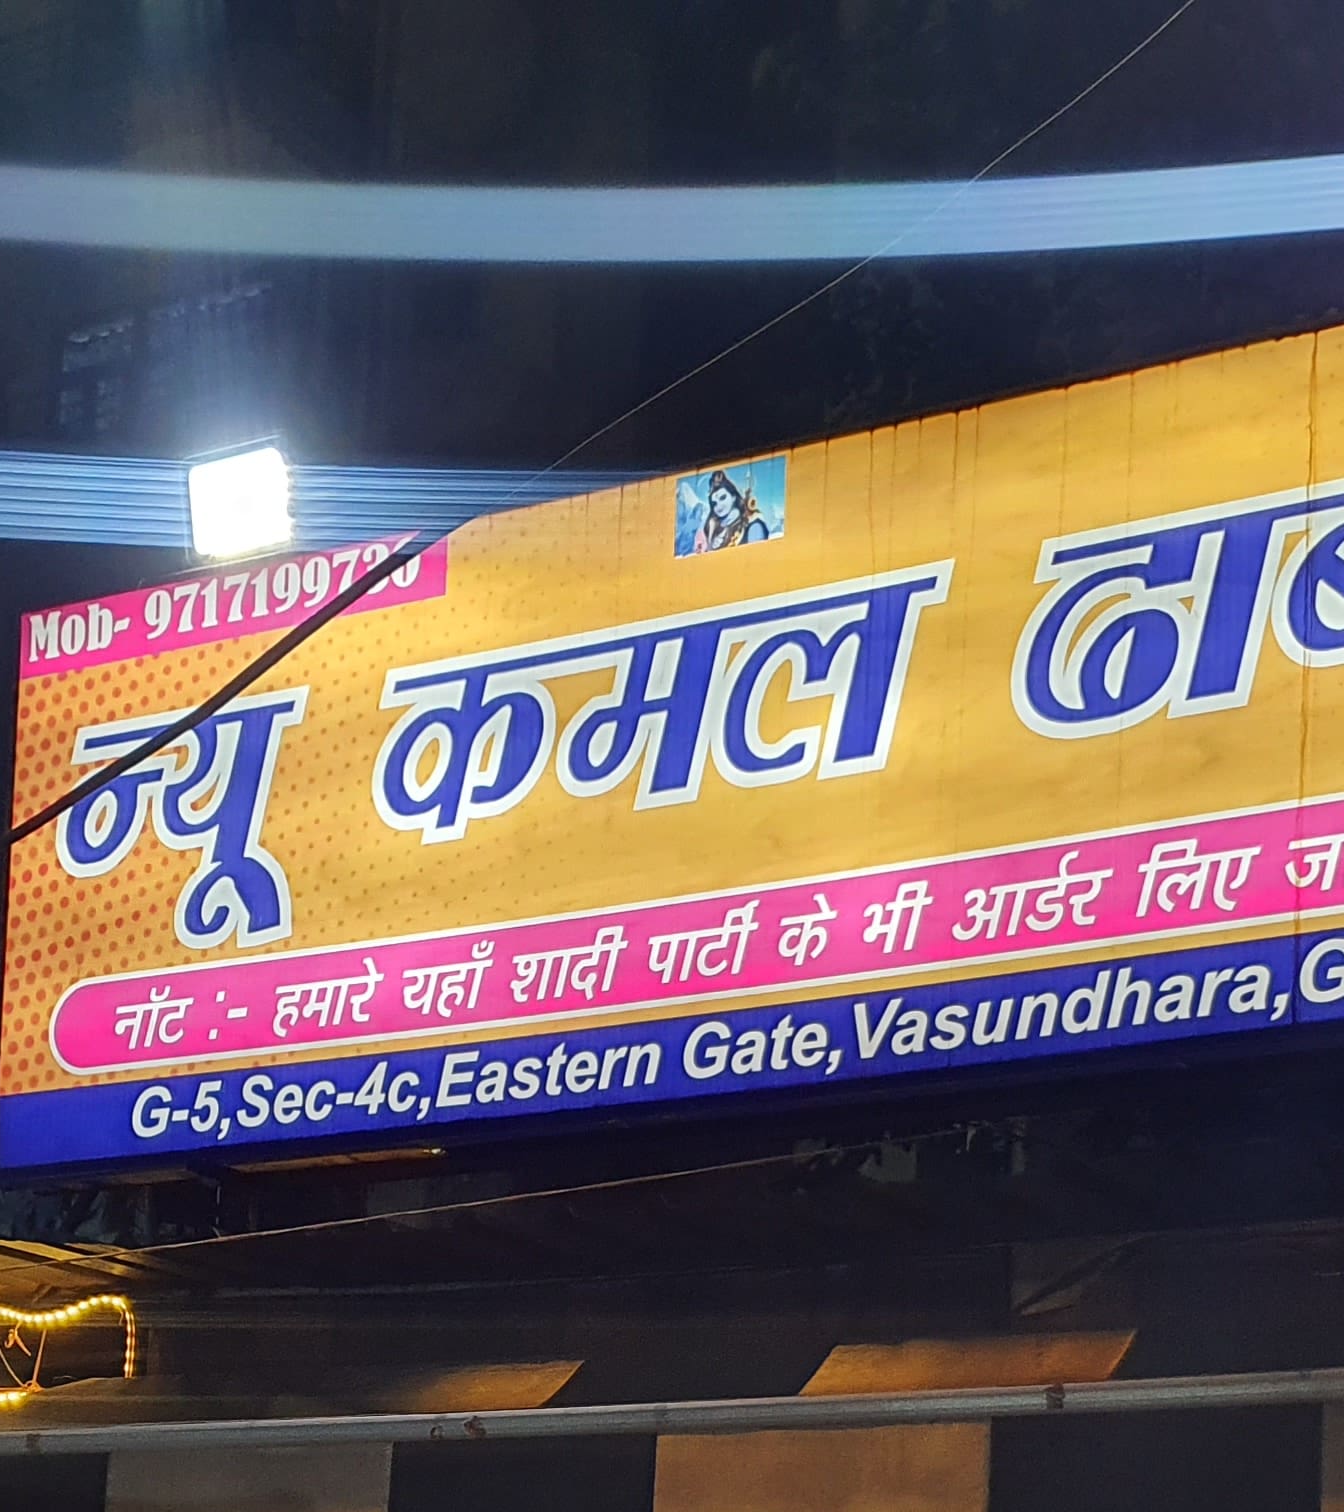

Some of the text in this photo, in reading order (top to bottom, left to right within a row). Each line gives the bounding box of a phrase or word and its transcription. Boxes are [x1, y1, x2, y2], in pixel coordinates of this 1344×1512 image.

[28, 536, 422, 663] Mob- 9717199730
[57, 686, 310, 948] न्यू
[372, 559, 955, 844] कमल
[272, 957, 385, 1038] हमारे
[401, 941, 494, 1019] यहाँ
[509, 926, 627, 1006] शादी
[648, 899, 760, 982] पार्टी
[778, 894, 837, 968] के
[861, 880, 932, 954] भी
[951, 852, 1112, 942] आर्डर
[1135, 838, 1260, 918] लिए
